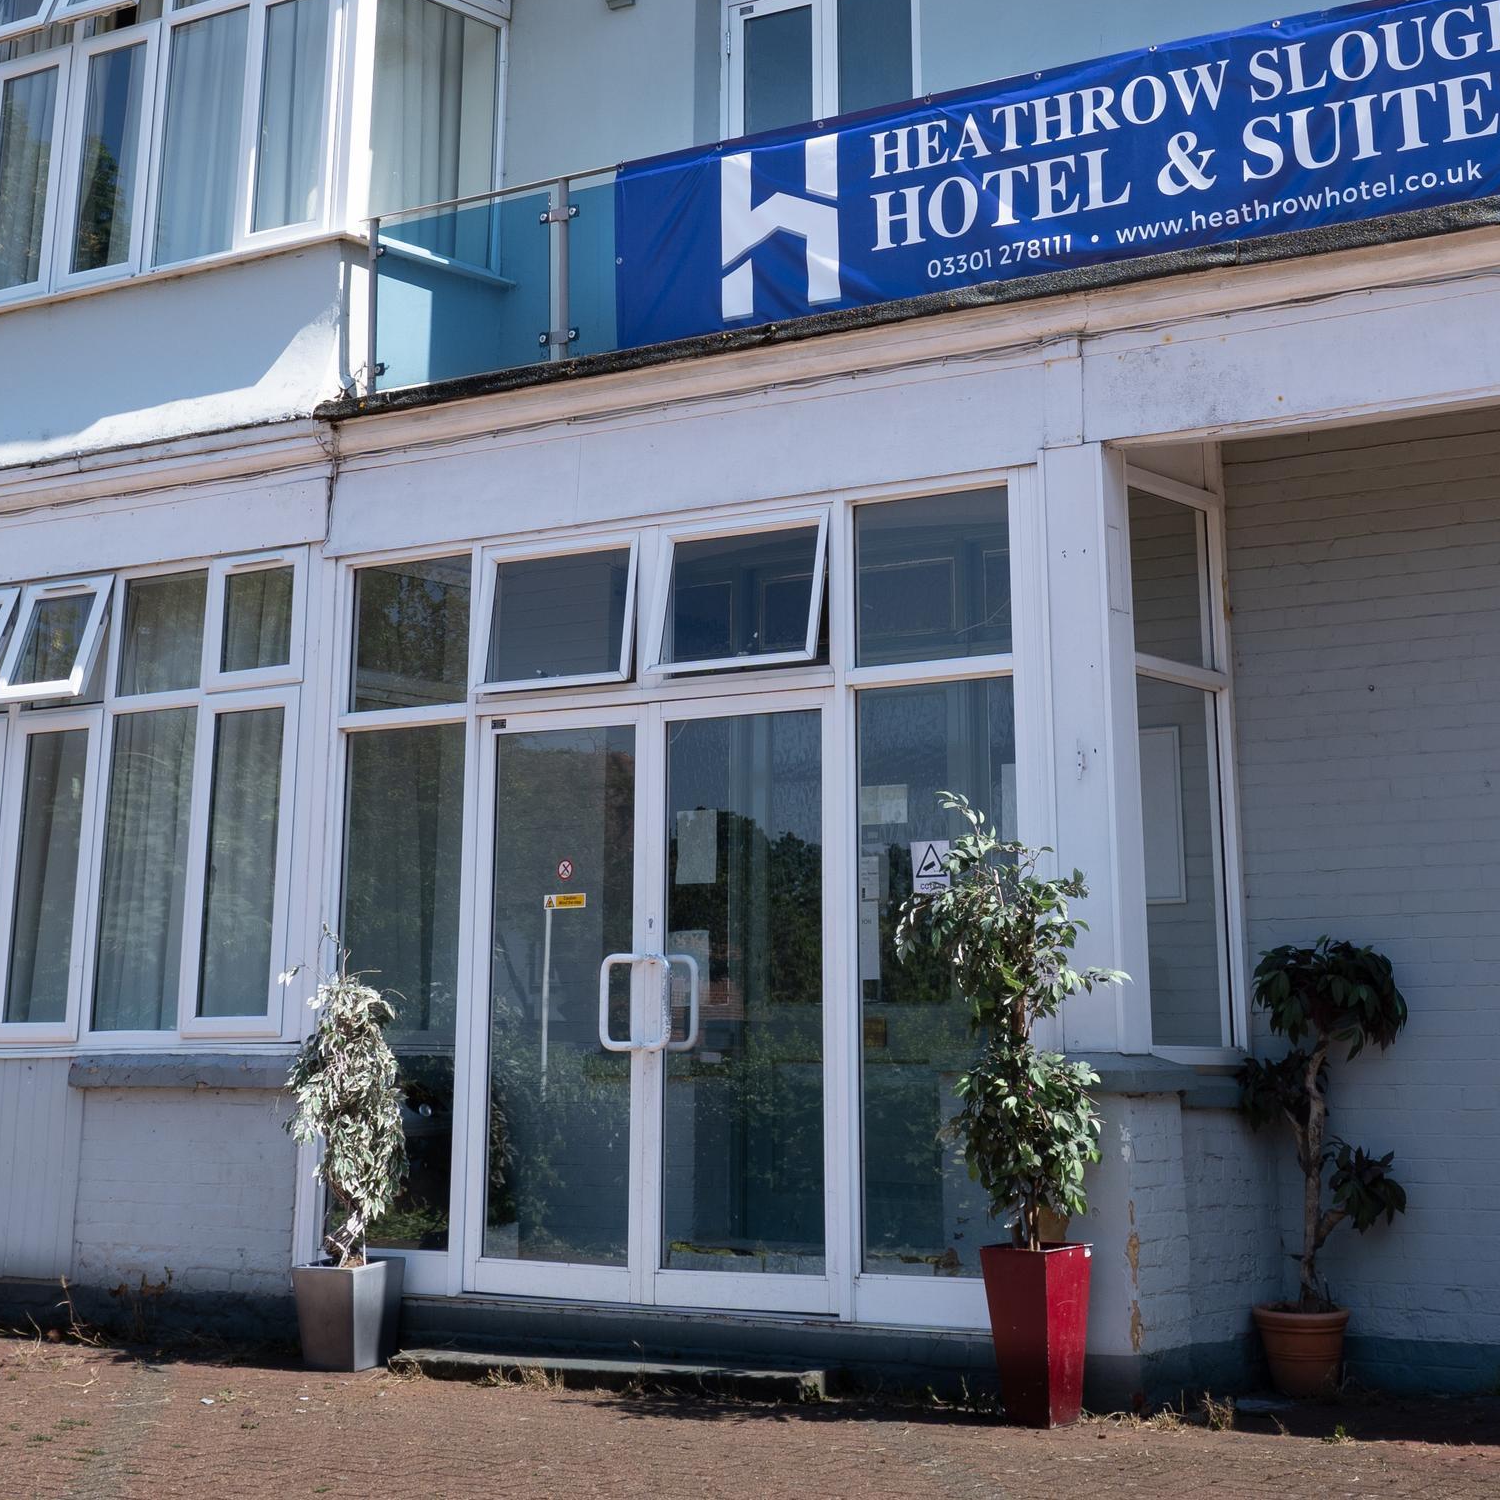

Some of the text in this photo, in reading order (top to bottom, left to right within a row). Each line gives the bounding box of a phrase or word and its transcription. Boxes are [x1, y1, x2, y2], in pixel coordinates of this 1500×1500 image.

[869, 59, 1231, 179] HEATHROW
[870, 148, 1131, 252] HOTEL
[1157, 131, 1217, 196] &
[927, 159, 1483, 279] 03301 278111 www.heathrowhotel.co.uk
